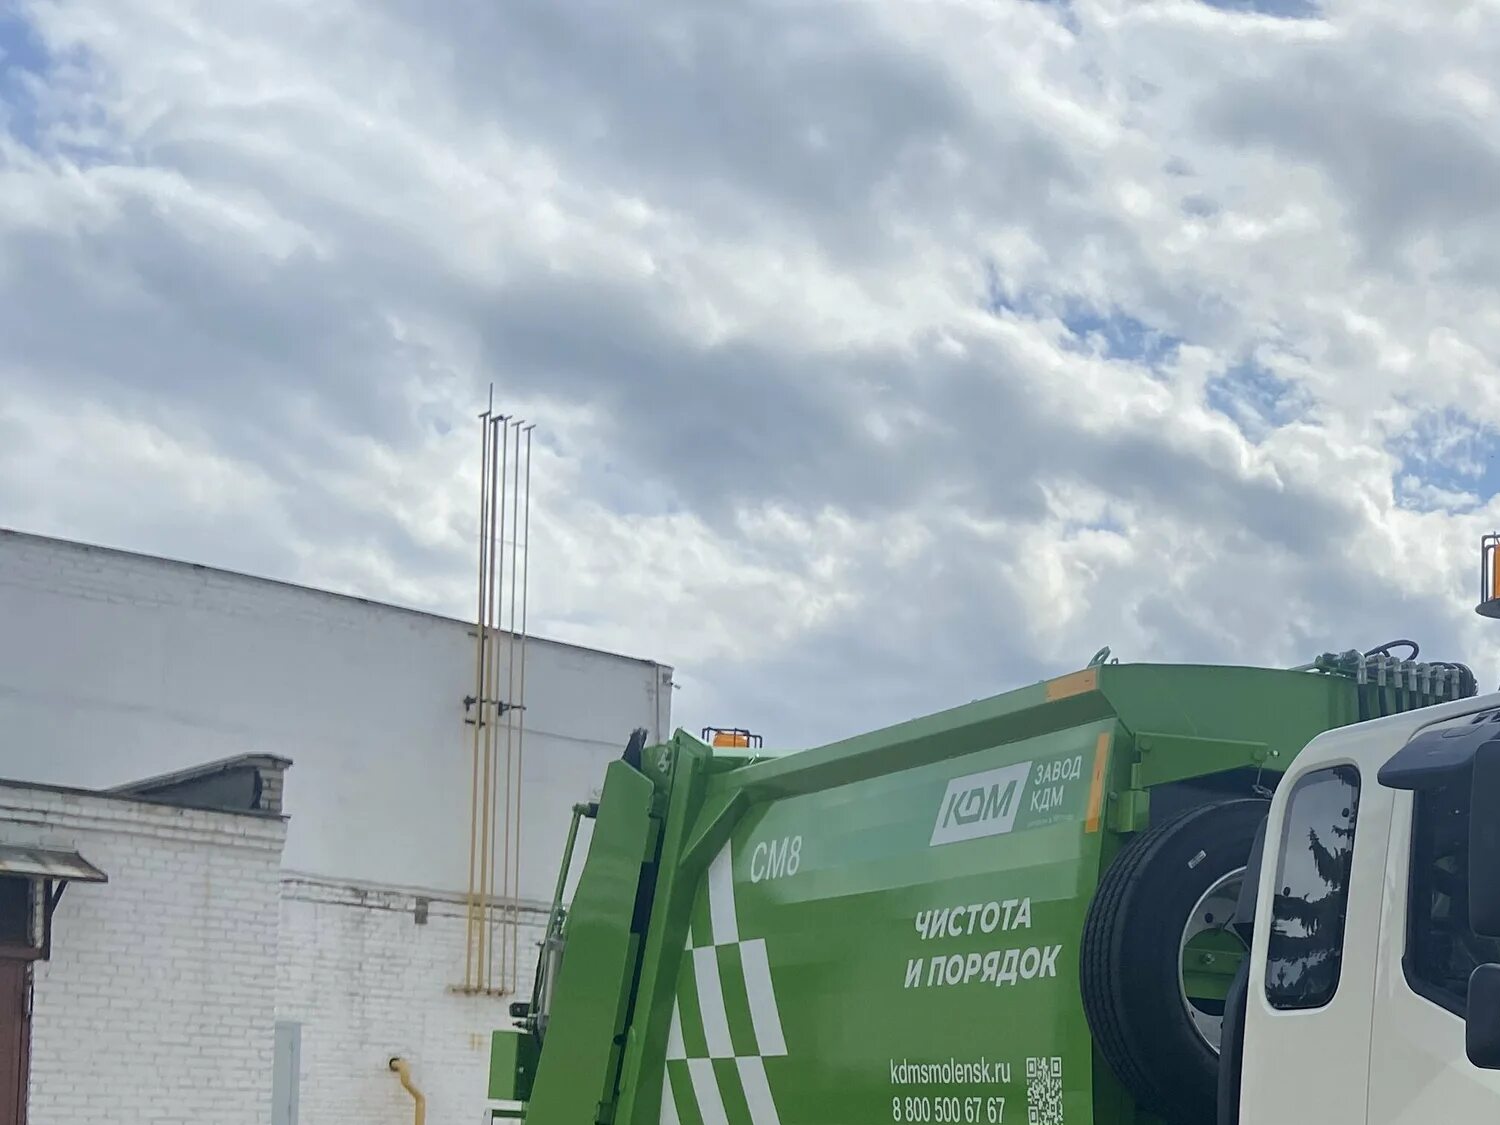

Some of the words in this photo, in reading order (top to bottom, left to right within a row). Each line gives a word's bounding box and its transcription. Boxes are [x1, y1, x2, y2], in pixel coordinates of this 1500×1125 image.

[1034, 755, 1082, 785] ЗАВОД
[942, 779, 1018, 829] KDM
[1030, 785, 1064, 812] КДМ
[750, 835, 802, 883] СМ8
[915, 897, 1032, 940] ЧИСТОТА
[904, 958, 923, 988] И
[927, 944, 1062, 988] ПОРЯДОК
[889, 1056, 1011, 1084] kdmsmolensk.ru
[892, 1096, 901, 1122] 8
[905, 1096, 930, 1122] 800
[934, 1096, 961, 1123] 500
[964, 1096, 982, 1123] 67
[986, 1096, 1005, 1124] 67
